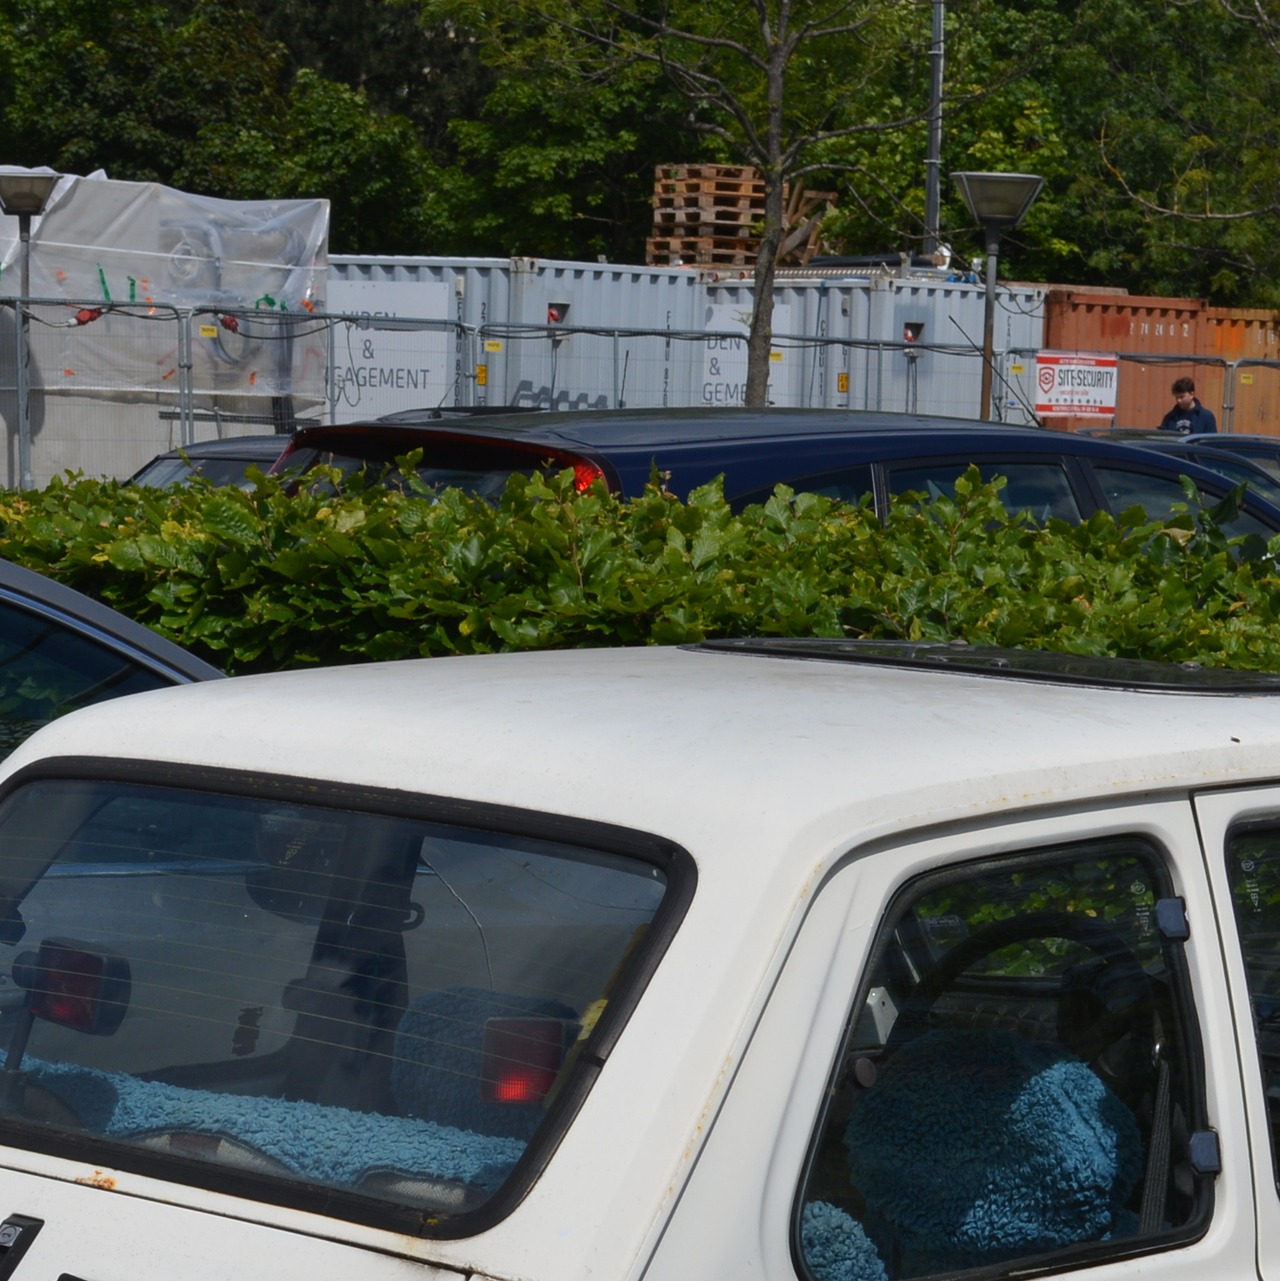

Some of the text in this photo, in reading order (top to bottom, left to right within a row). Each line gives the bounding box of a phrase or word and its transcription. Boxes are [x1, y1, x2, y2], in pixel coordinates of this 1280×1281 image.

[362, 339, 375, 360] &
[709, 357, 721, 376] &
[1058, 369, 1114, 388] SITE-SECURITY
